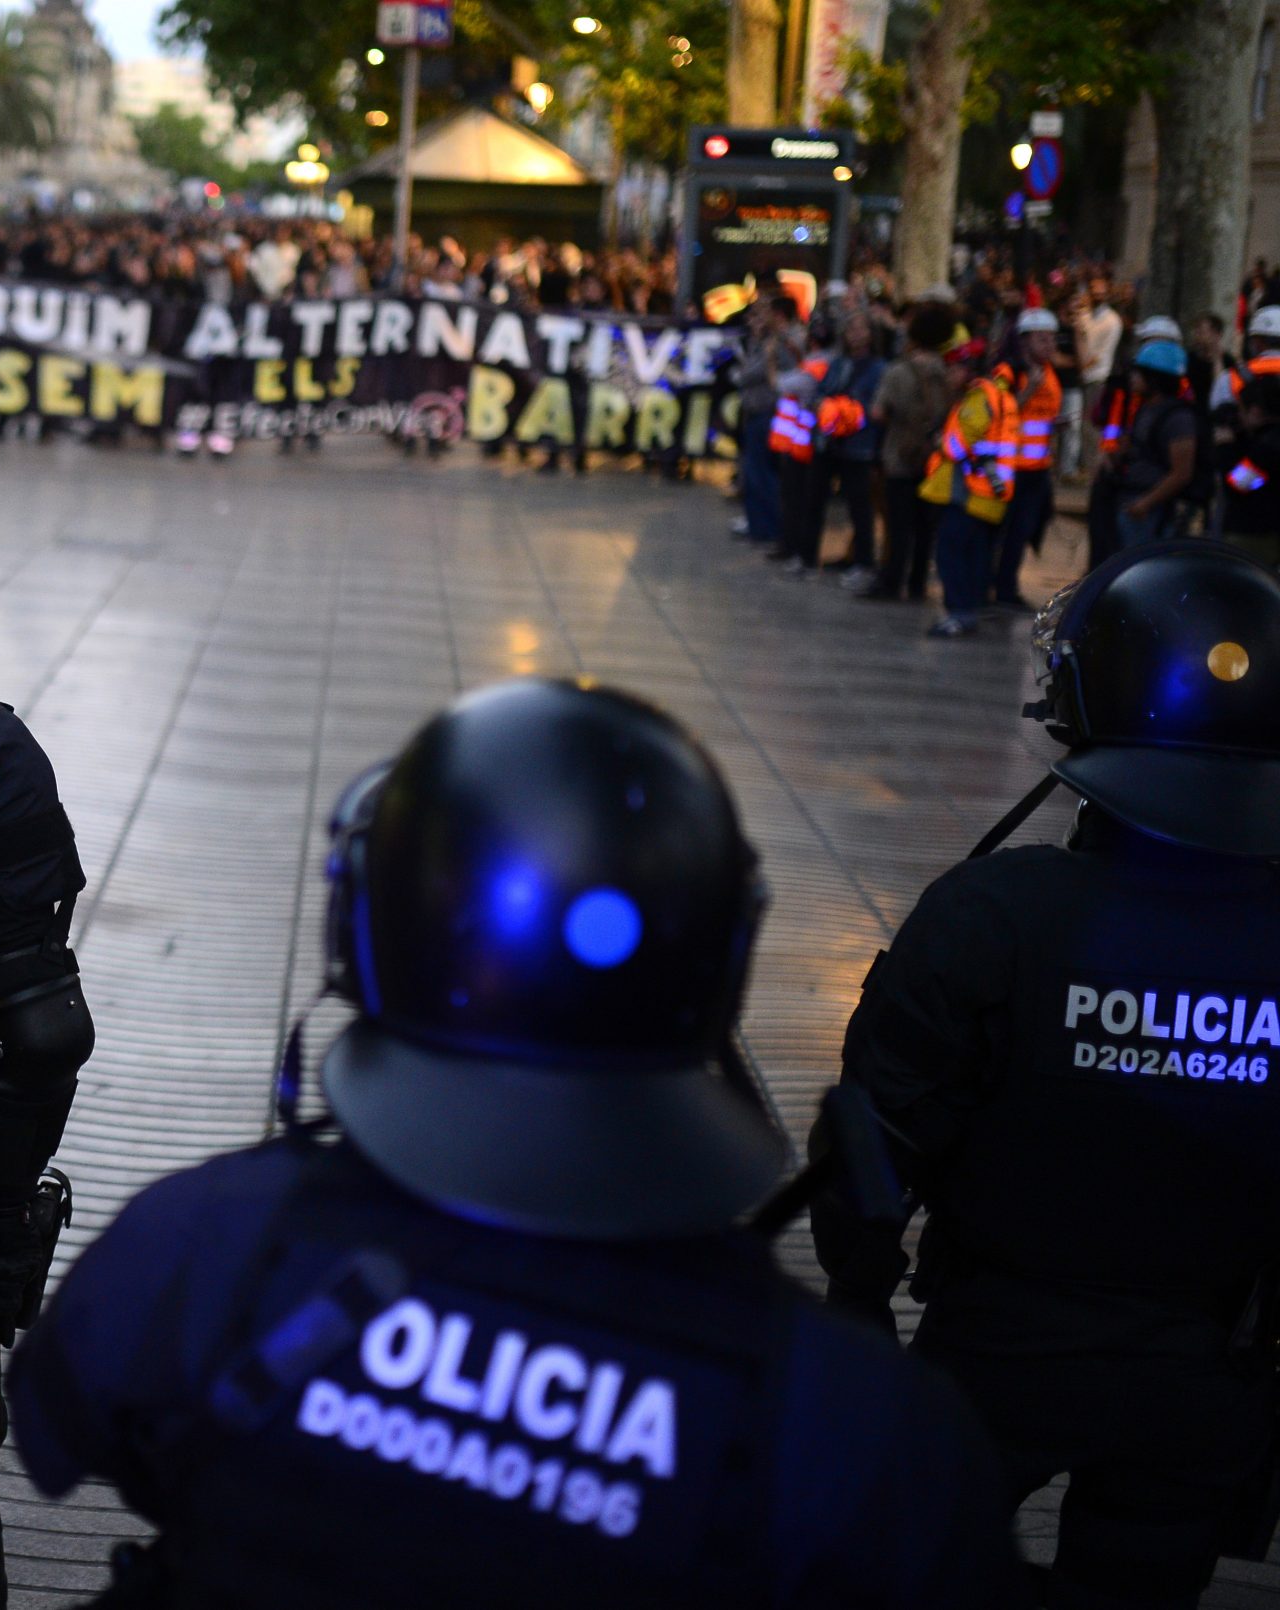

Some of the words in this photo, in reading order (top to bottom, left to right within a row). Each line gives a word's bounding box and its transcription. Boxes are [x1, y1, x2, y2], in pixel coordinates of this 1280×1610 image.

[184, 302, 724, 385] ALTERNATIVE
[253, 357, 361, 403] ELS
[1065, 984, 1280, 1046] POLICIA
[1073, 1041, 1269, 1083] D202A6246
[359, 1297, 678, 1480] OLICIA
[297, 1377, 642, 1539] D000A0196
